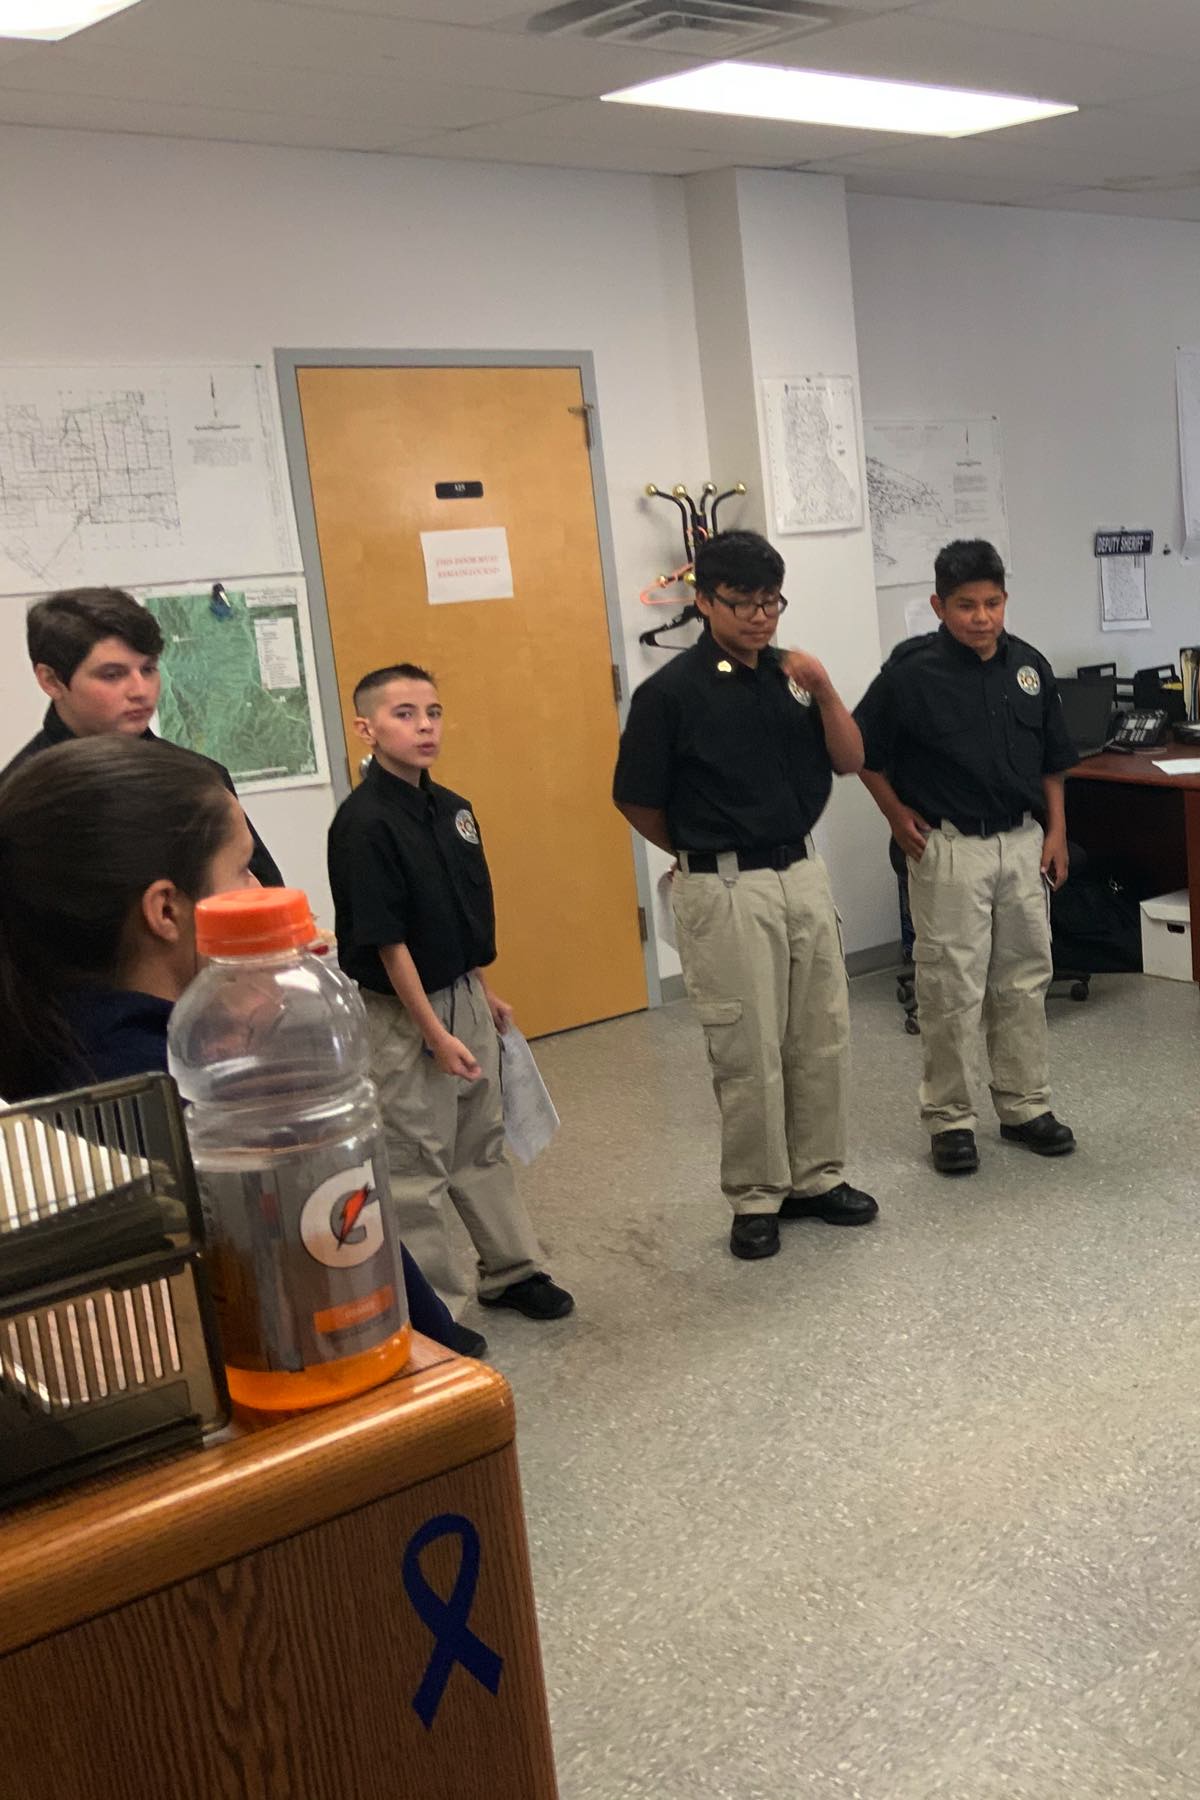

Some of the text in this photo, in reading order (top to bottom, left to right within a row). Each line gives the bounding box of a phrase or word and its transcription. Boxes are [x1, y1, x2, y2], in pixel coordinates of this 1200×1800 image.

[1097, 535, 1144, 553] DEPUTY SHERIFF
[300, 1158, 385, 1269] G
